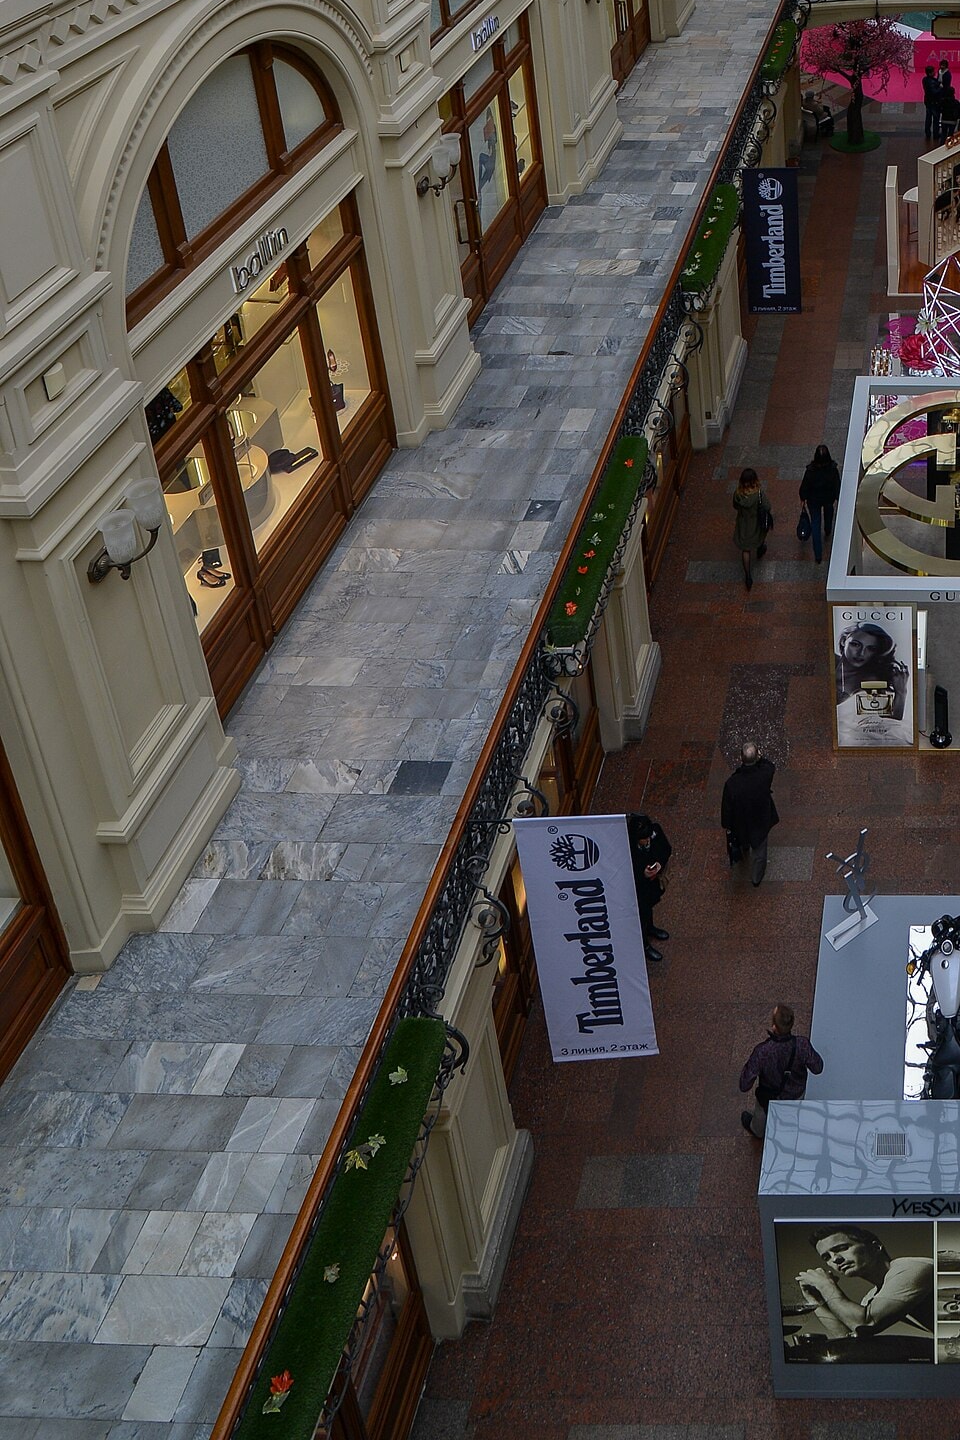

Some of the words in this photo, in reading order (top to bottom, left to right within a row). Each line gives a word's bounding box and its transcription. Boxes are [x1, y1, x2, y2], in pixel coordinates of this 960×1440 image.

[759, 204, 787, 299] Timberland
[842, 611, 904, 621] GUCCI
[554, 878, 624, 1034] Timberland
[561, 1047, 569, 1056] 3
[610, 1044, 618, 1052] 2
[620, 1042, 649, 1051] этаж
